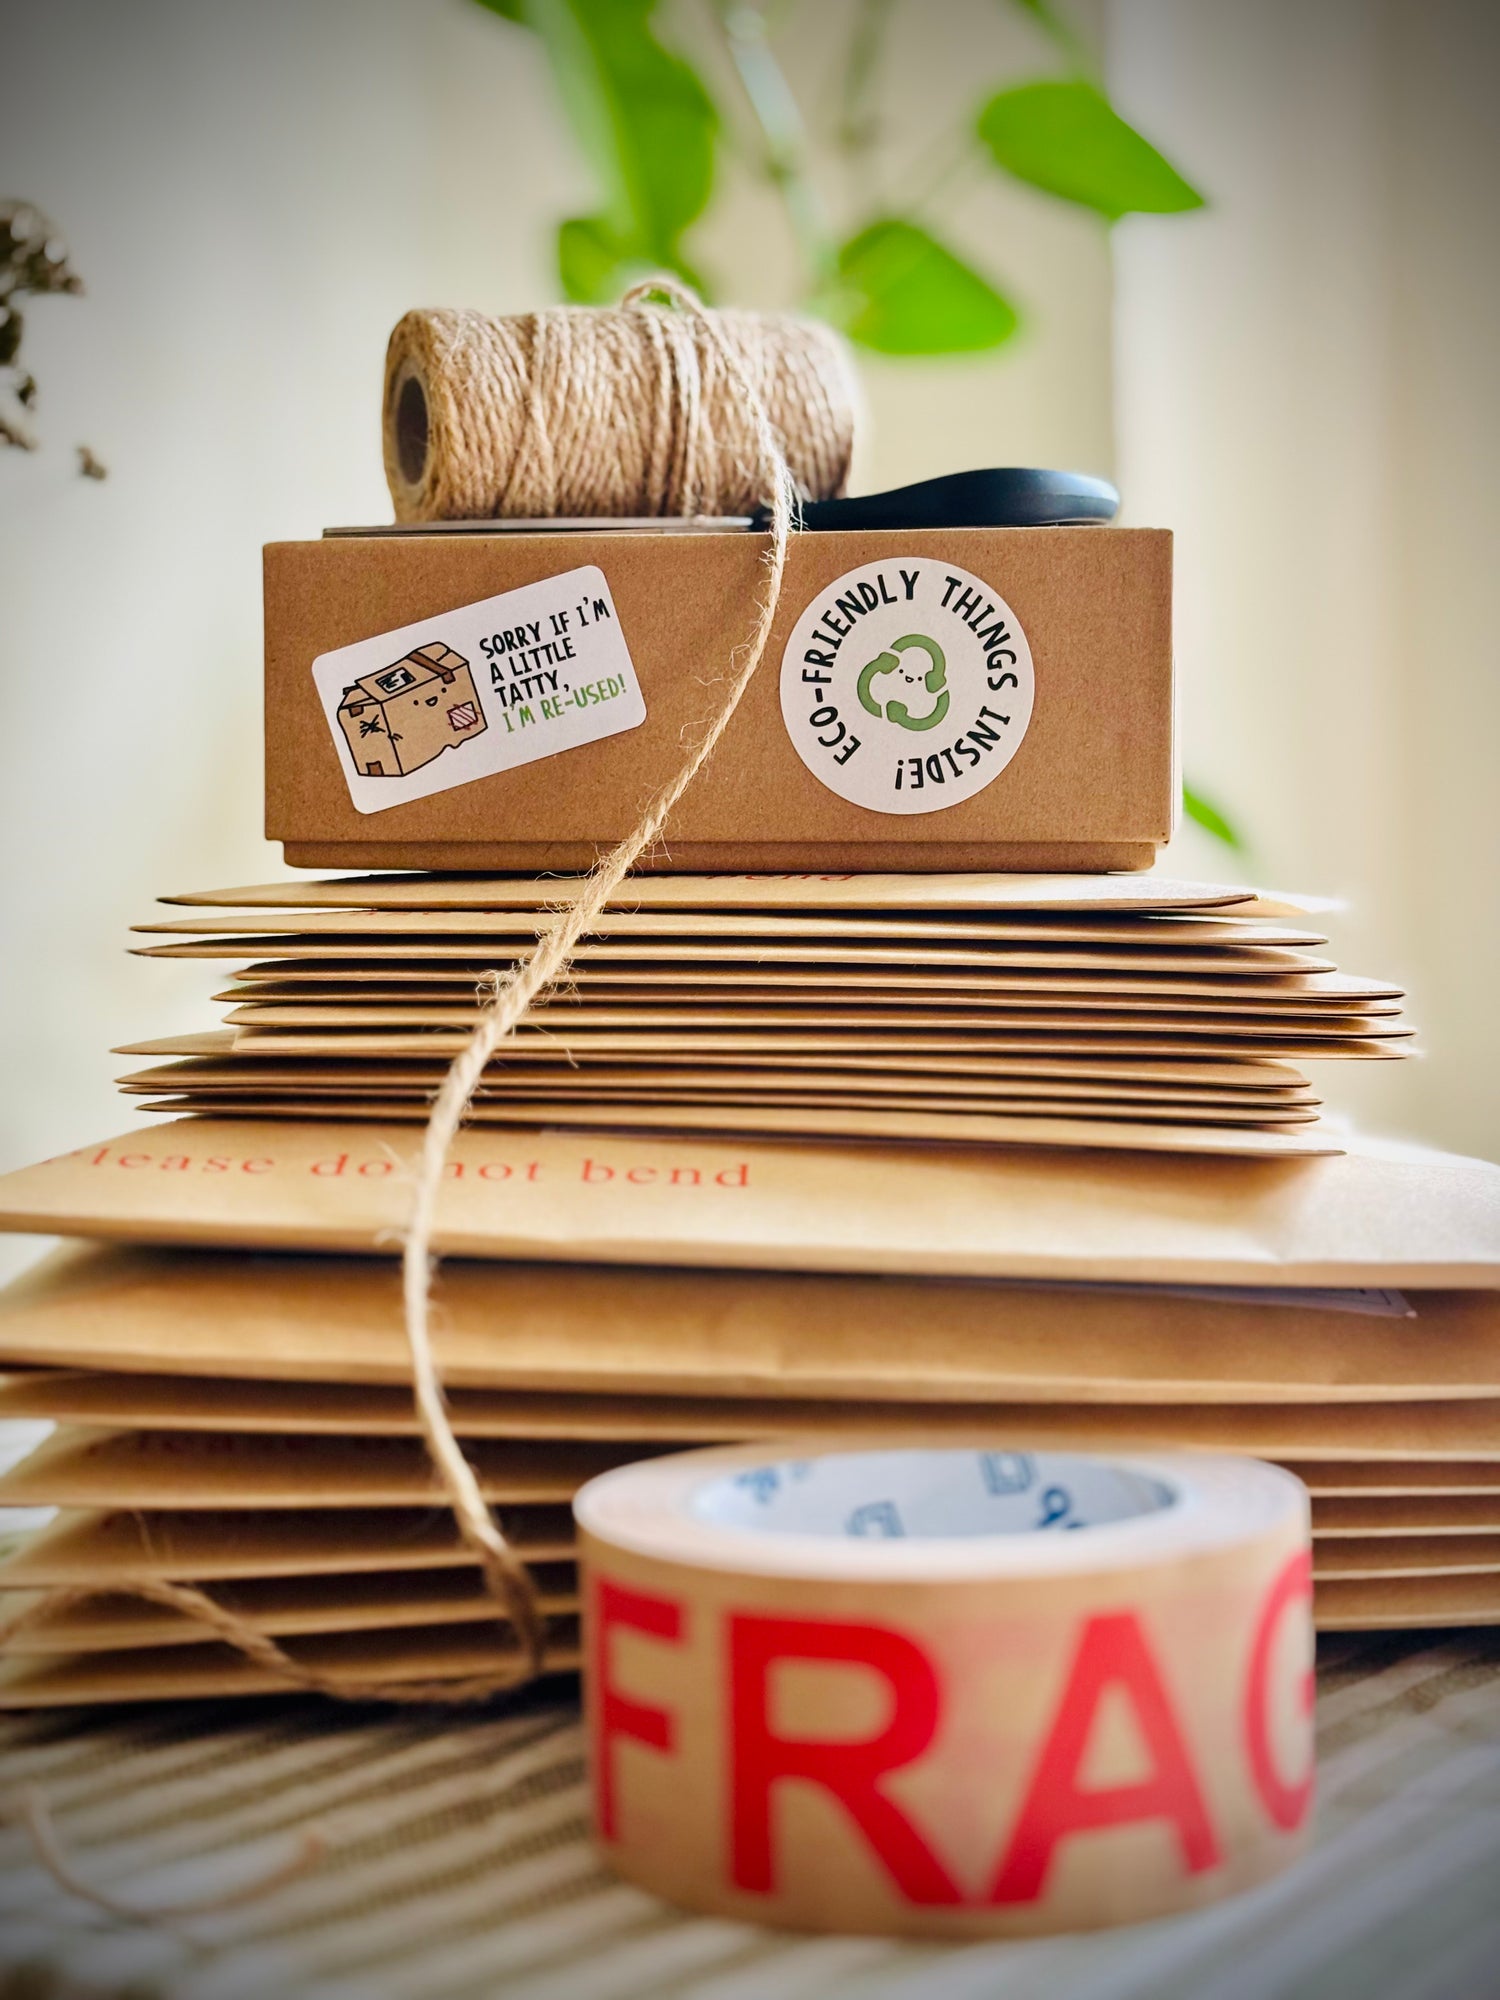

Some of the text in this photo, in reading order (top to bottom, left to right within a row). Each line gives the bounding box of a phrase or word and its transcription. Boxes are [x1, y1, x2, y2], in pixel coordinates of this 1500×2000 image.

[479, 596, 611, 661] SORRY IF I'M
[489, 637, 577, 685] A LITTLE
[801, 570, 1019, 790] ECO-FRIENDLY THINGS INSIDE!
[494, 669, 570, 709] TATTY,
[502, 673, 627, 733] I'M RE-USED!
[42, 1146, 276, 1175] lease
[309, 1152, 394, 1178] do
[580, 1157, 751, 1189] bend
